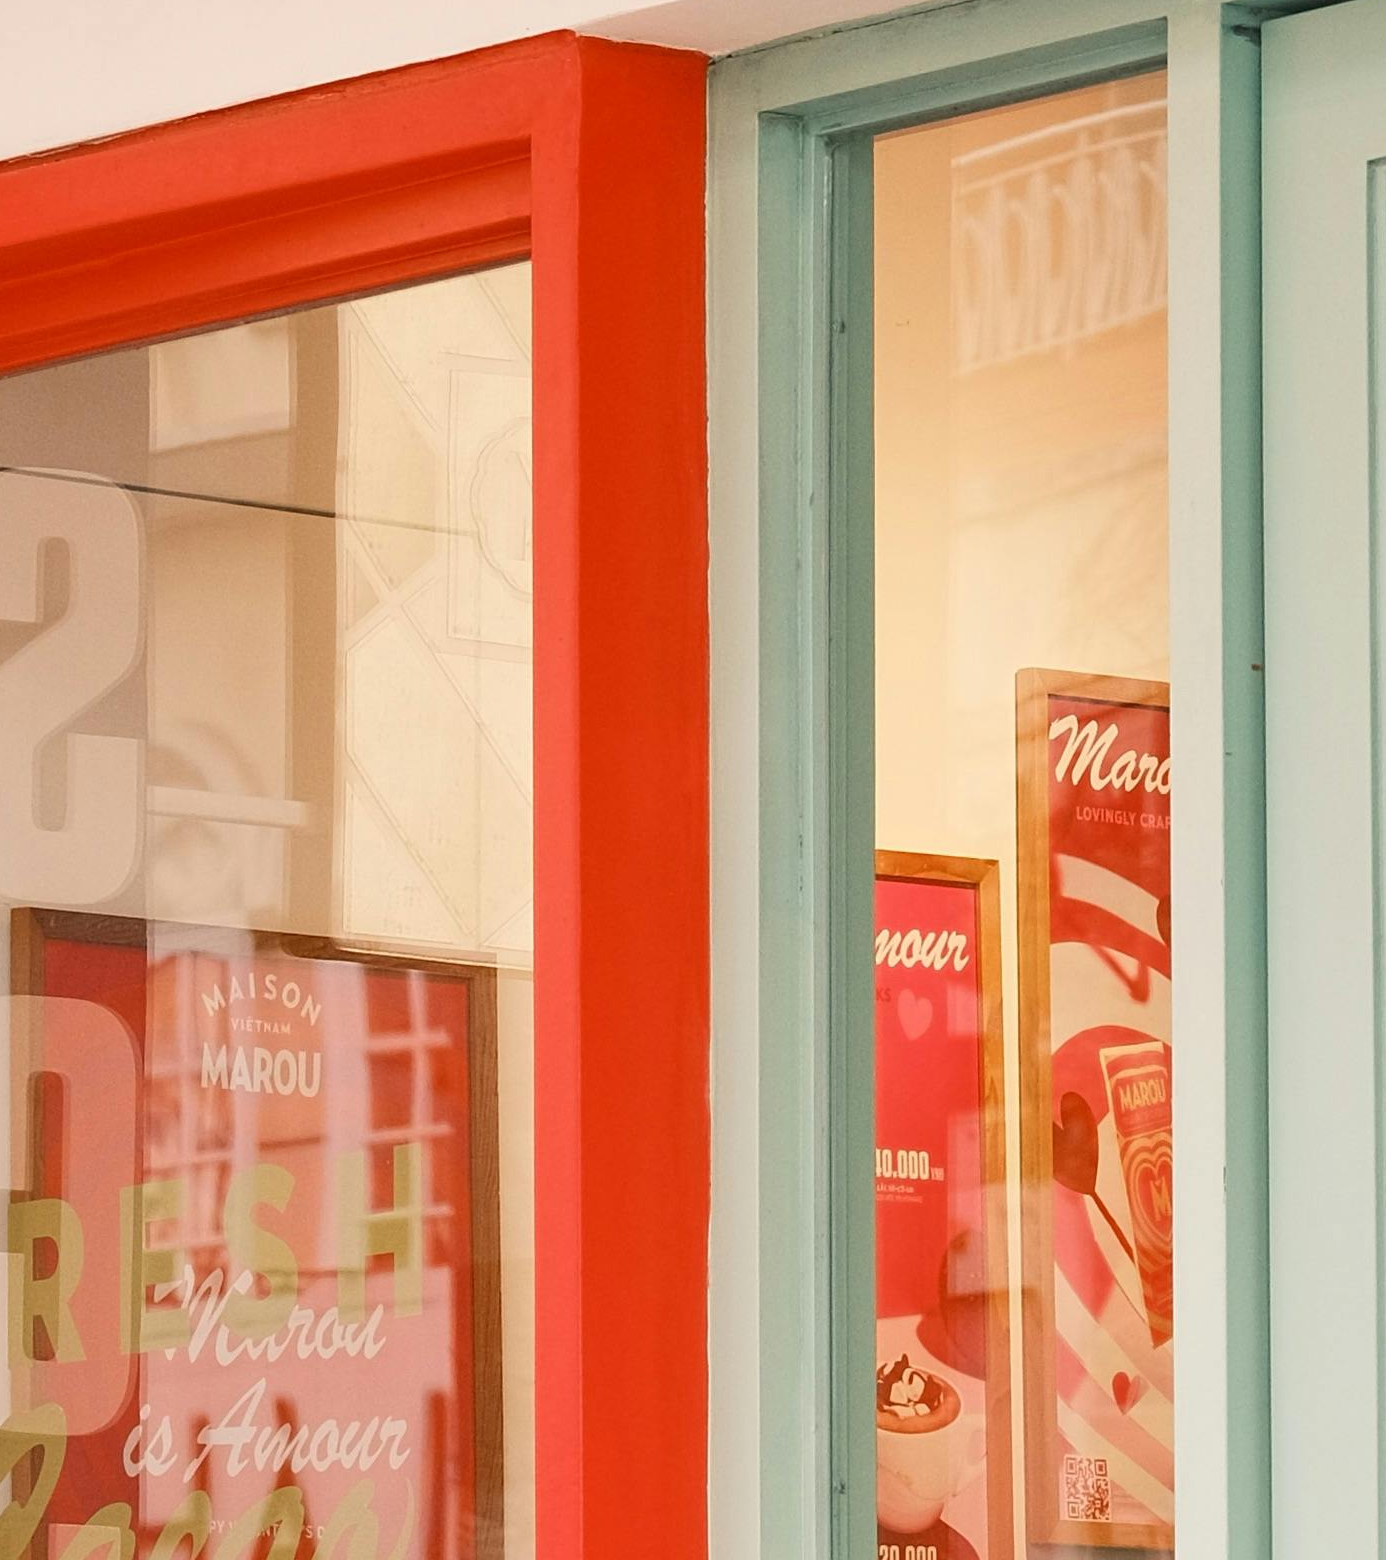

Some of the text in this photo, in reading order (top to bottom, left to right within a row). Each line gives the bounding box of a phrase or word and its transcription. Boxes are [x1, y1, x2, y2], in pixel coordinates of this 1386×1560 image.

[1049, 714, 1171, 795] Maro
[1076, 806, 1137, 826] LOVINGLY
[201, 972, 322, 1026] MAISON
[201, 1040, 322, 1098] MAROU
[1118, 1077, 1167, 1113] MAROU
[153, 1264, 387, 1366] Mrou
[123, 1377, 411, 1483] is Amour
